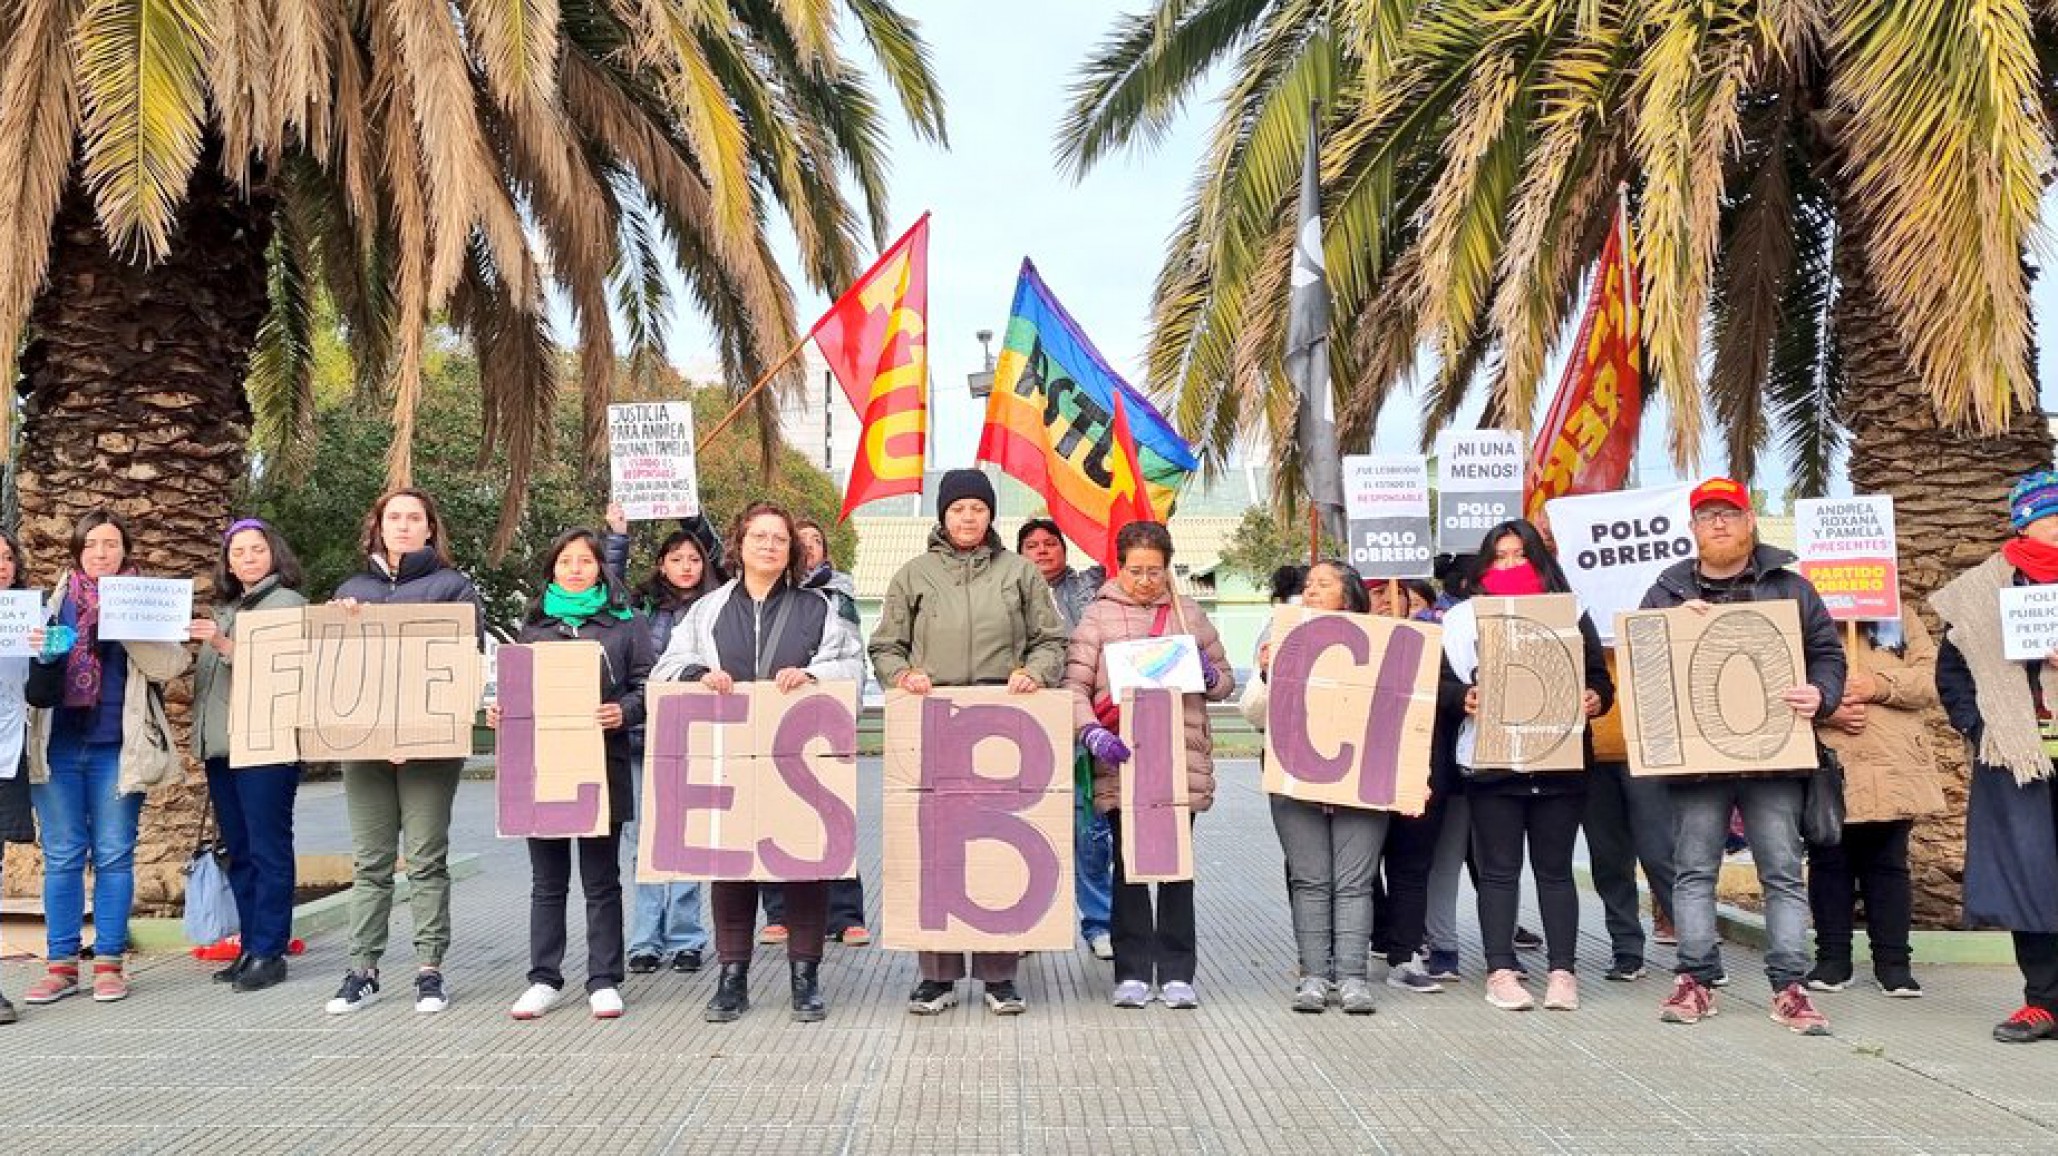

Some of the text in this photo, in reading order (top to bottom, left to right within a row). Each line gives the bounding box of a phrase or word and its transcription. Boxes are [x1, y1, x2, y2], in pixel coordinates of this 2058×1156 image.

[611, 404, 670, 423] JUSTICIA
[611, 422, 685, 441] PARA ANDREA
[1453, 442, 1516, 459] ¡NI UNA
[1451, 463, 1518, 478] MENOS!
[1357, 493, 1423, 502] RESPONSABLE
[1458, 502, 1506, 515] POLO
[1445, 516, 1516, 529] OBRER
[1821, 514, 1879, 527] ROXANA
[1591, 516, 1671, 544] POLO
[1813, 526, 1885, 540] Y PAMELA
[1366, 531, 1417, 547] POLO
[1355, 547, 1430, 562] OBRERO
[1578, 536, 1693, 571] OBRERO
[1810, 566, 1886, 579] PARTIDO
[1814, 578, 1884, 592] OBRERO
[248, 617, 459, 752] FUE
